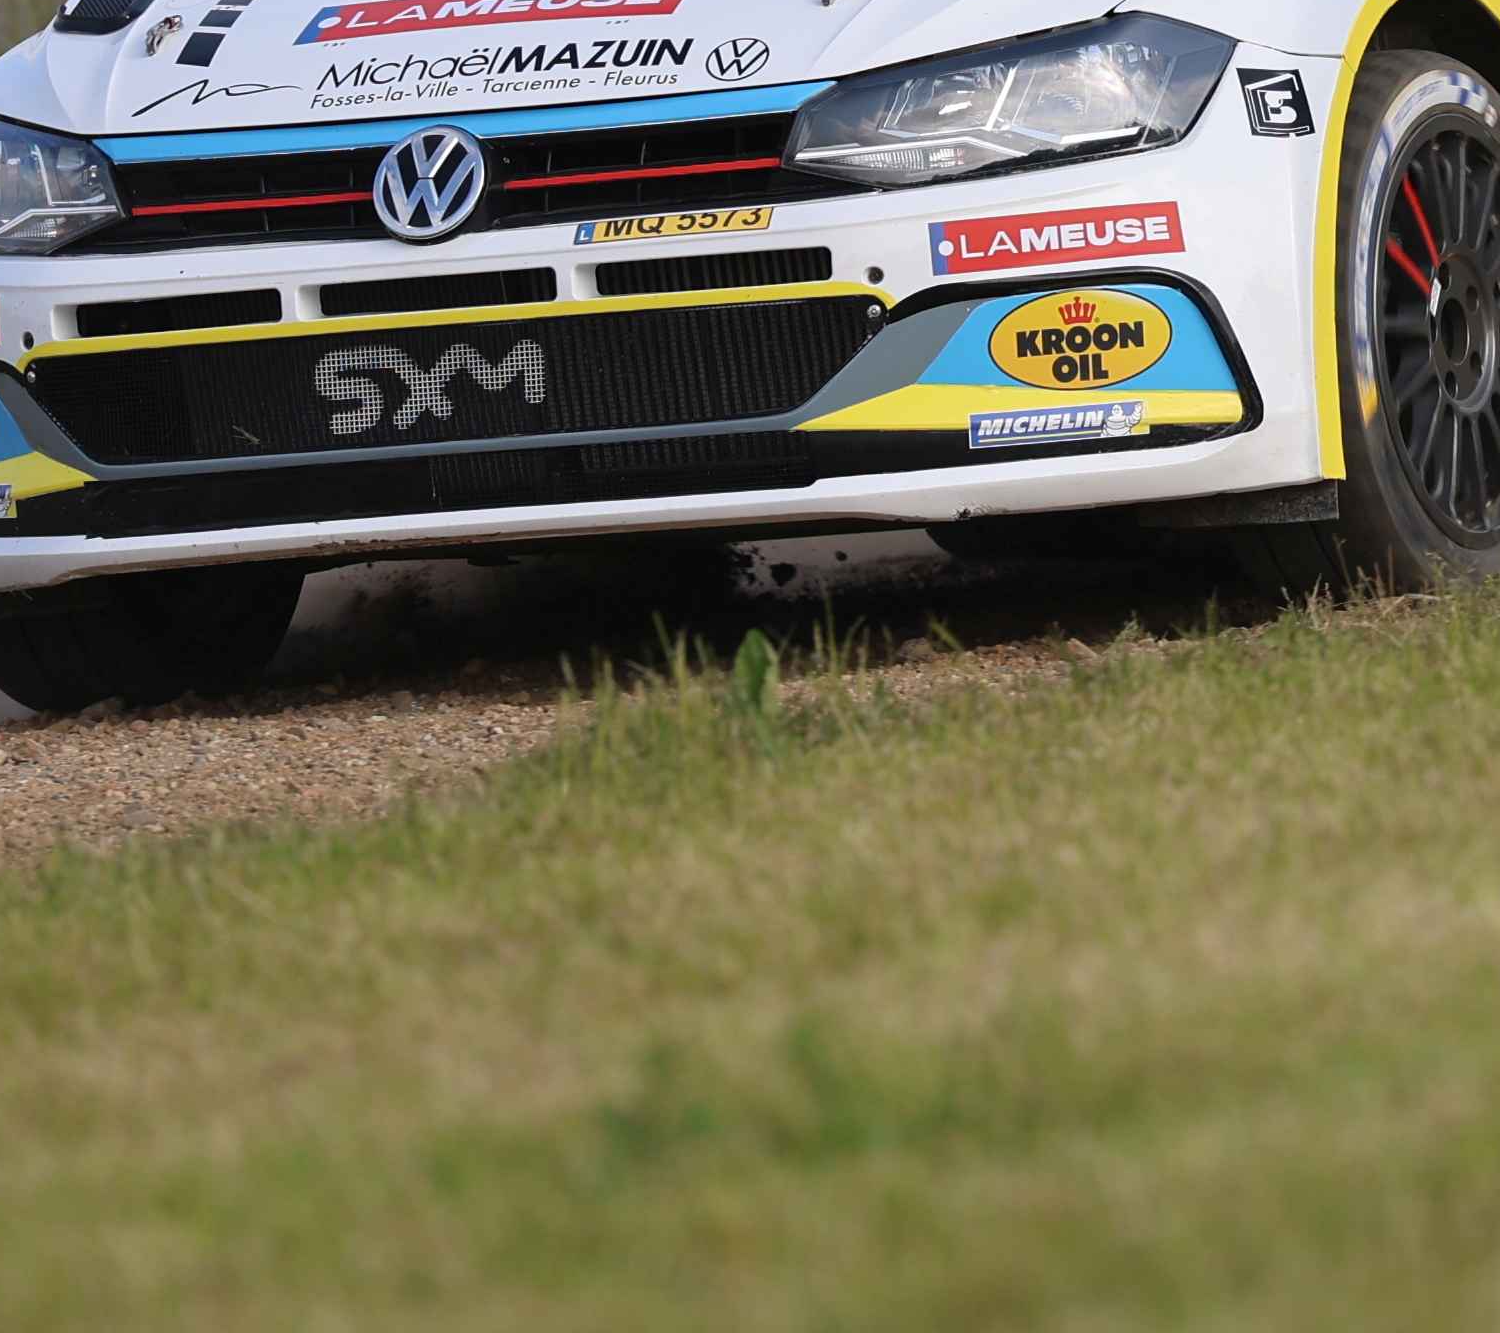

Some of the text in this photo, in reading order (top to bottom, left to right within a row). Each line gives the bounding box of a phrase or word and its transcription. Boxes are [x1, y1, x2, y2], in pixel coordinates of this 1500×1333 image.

[316, 47, 503, 91] Michaël
[499, 38, 694, 74] MAZUIN
[310, 83, 458, 109] Fosses-la-Ville
[483, 77, 580, 93] Tarcienne
[603, 70, 678, 86] Fleurus
[959, 215, 1171, 259] LAMEUSE
[1016, 320, 1145, 358] KROON
[314, 339, 547, 434] SXM
[1052, 353, 1109, 383] OIL
[977, 409, 1105, 436] MICHELIN
